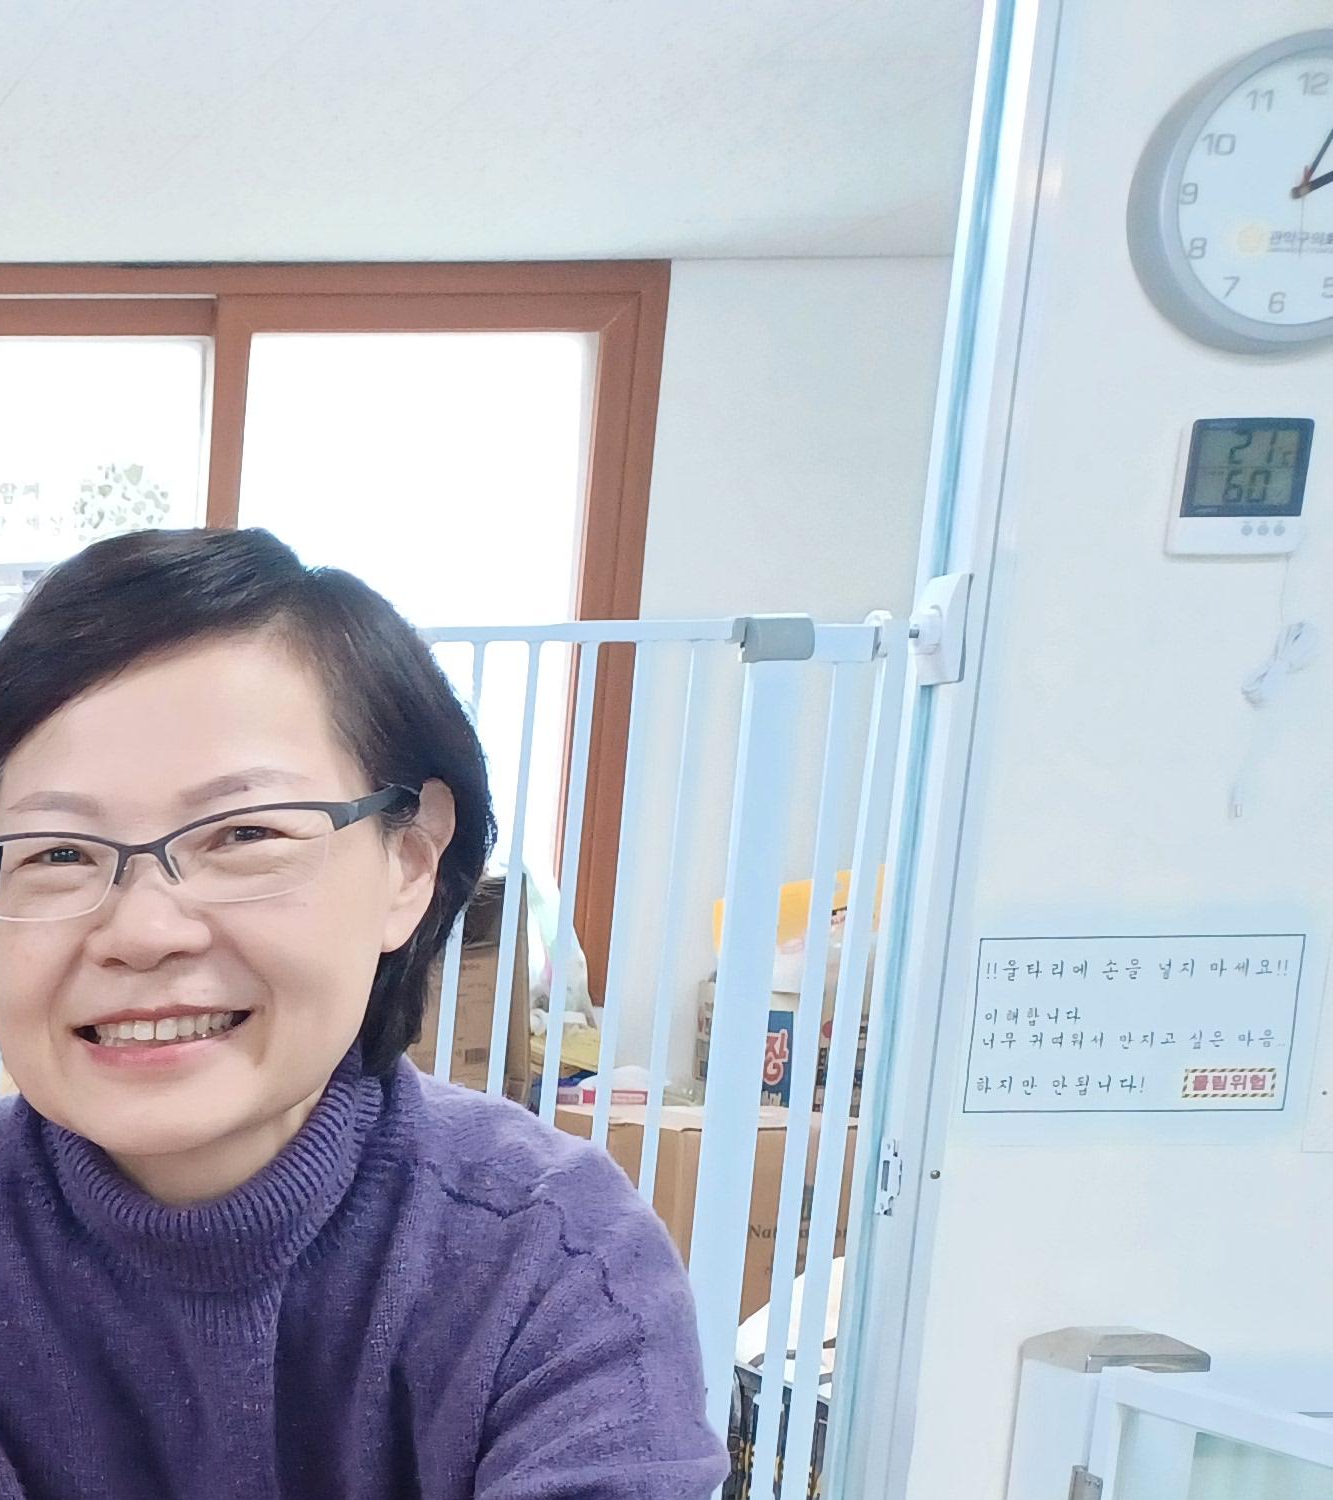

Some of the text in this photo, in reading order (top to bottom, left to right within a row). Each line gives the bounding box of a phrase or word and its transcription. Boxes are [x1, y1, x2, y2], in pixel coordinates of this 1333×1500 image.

[1297, 71, 1330, 96] 12
[1247, 88, 1275, 112] 11
[1201, 132, 1236, 156] 10
[1180, 182, 1199, 205] 9
[1187, 237, 1208, 260] 8
[1222, 275, 1240, 299] 7
[1267, 291, 1287, 315] 6
[983, 1031, 1017, 1049] 너무
